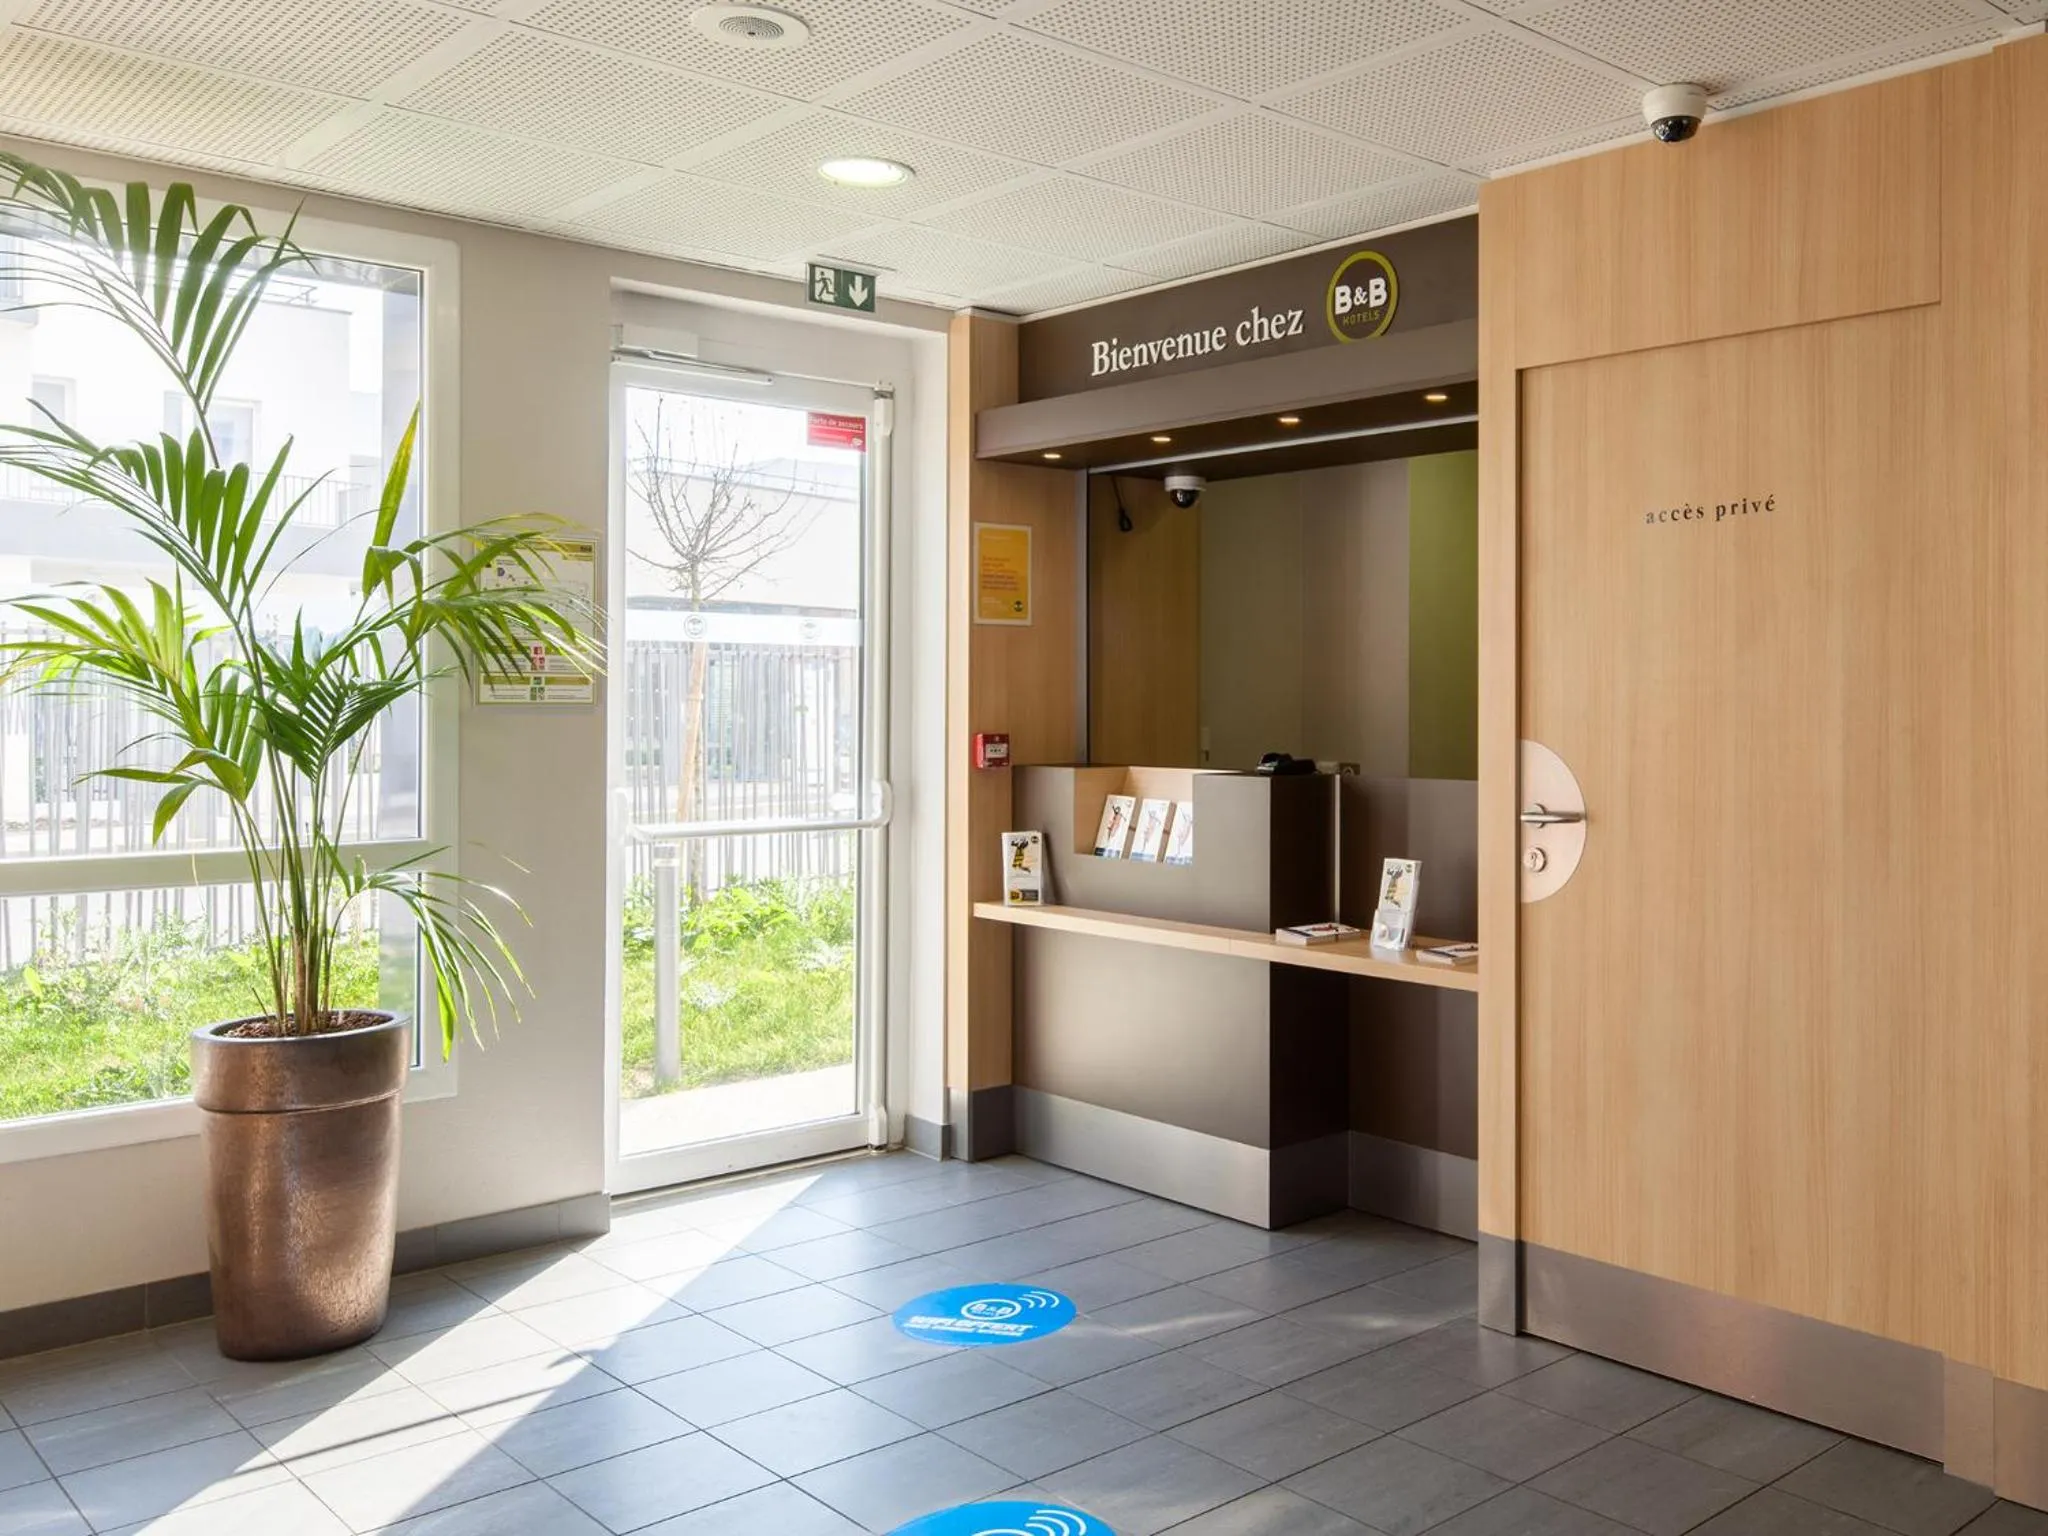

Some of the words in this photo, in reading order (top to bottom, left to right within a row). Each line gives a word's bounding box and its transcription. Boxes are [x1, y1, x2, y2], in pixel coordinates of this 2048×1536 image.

[1335, 278, 1387, 315] B&B
[1343, 311, 1380, 326] HOTELS
[1091, 326, 1227, 377] Bienvenue
[1235, 306, 1304, 346] chez
[1646, 503, 1705, 524] accès
[1715, 494, 1776, 522] privé
